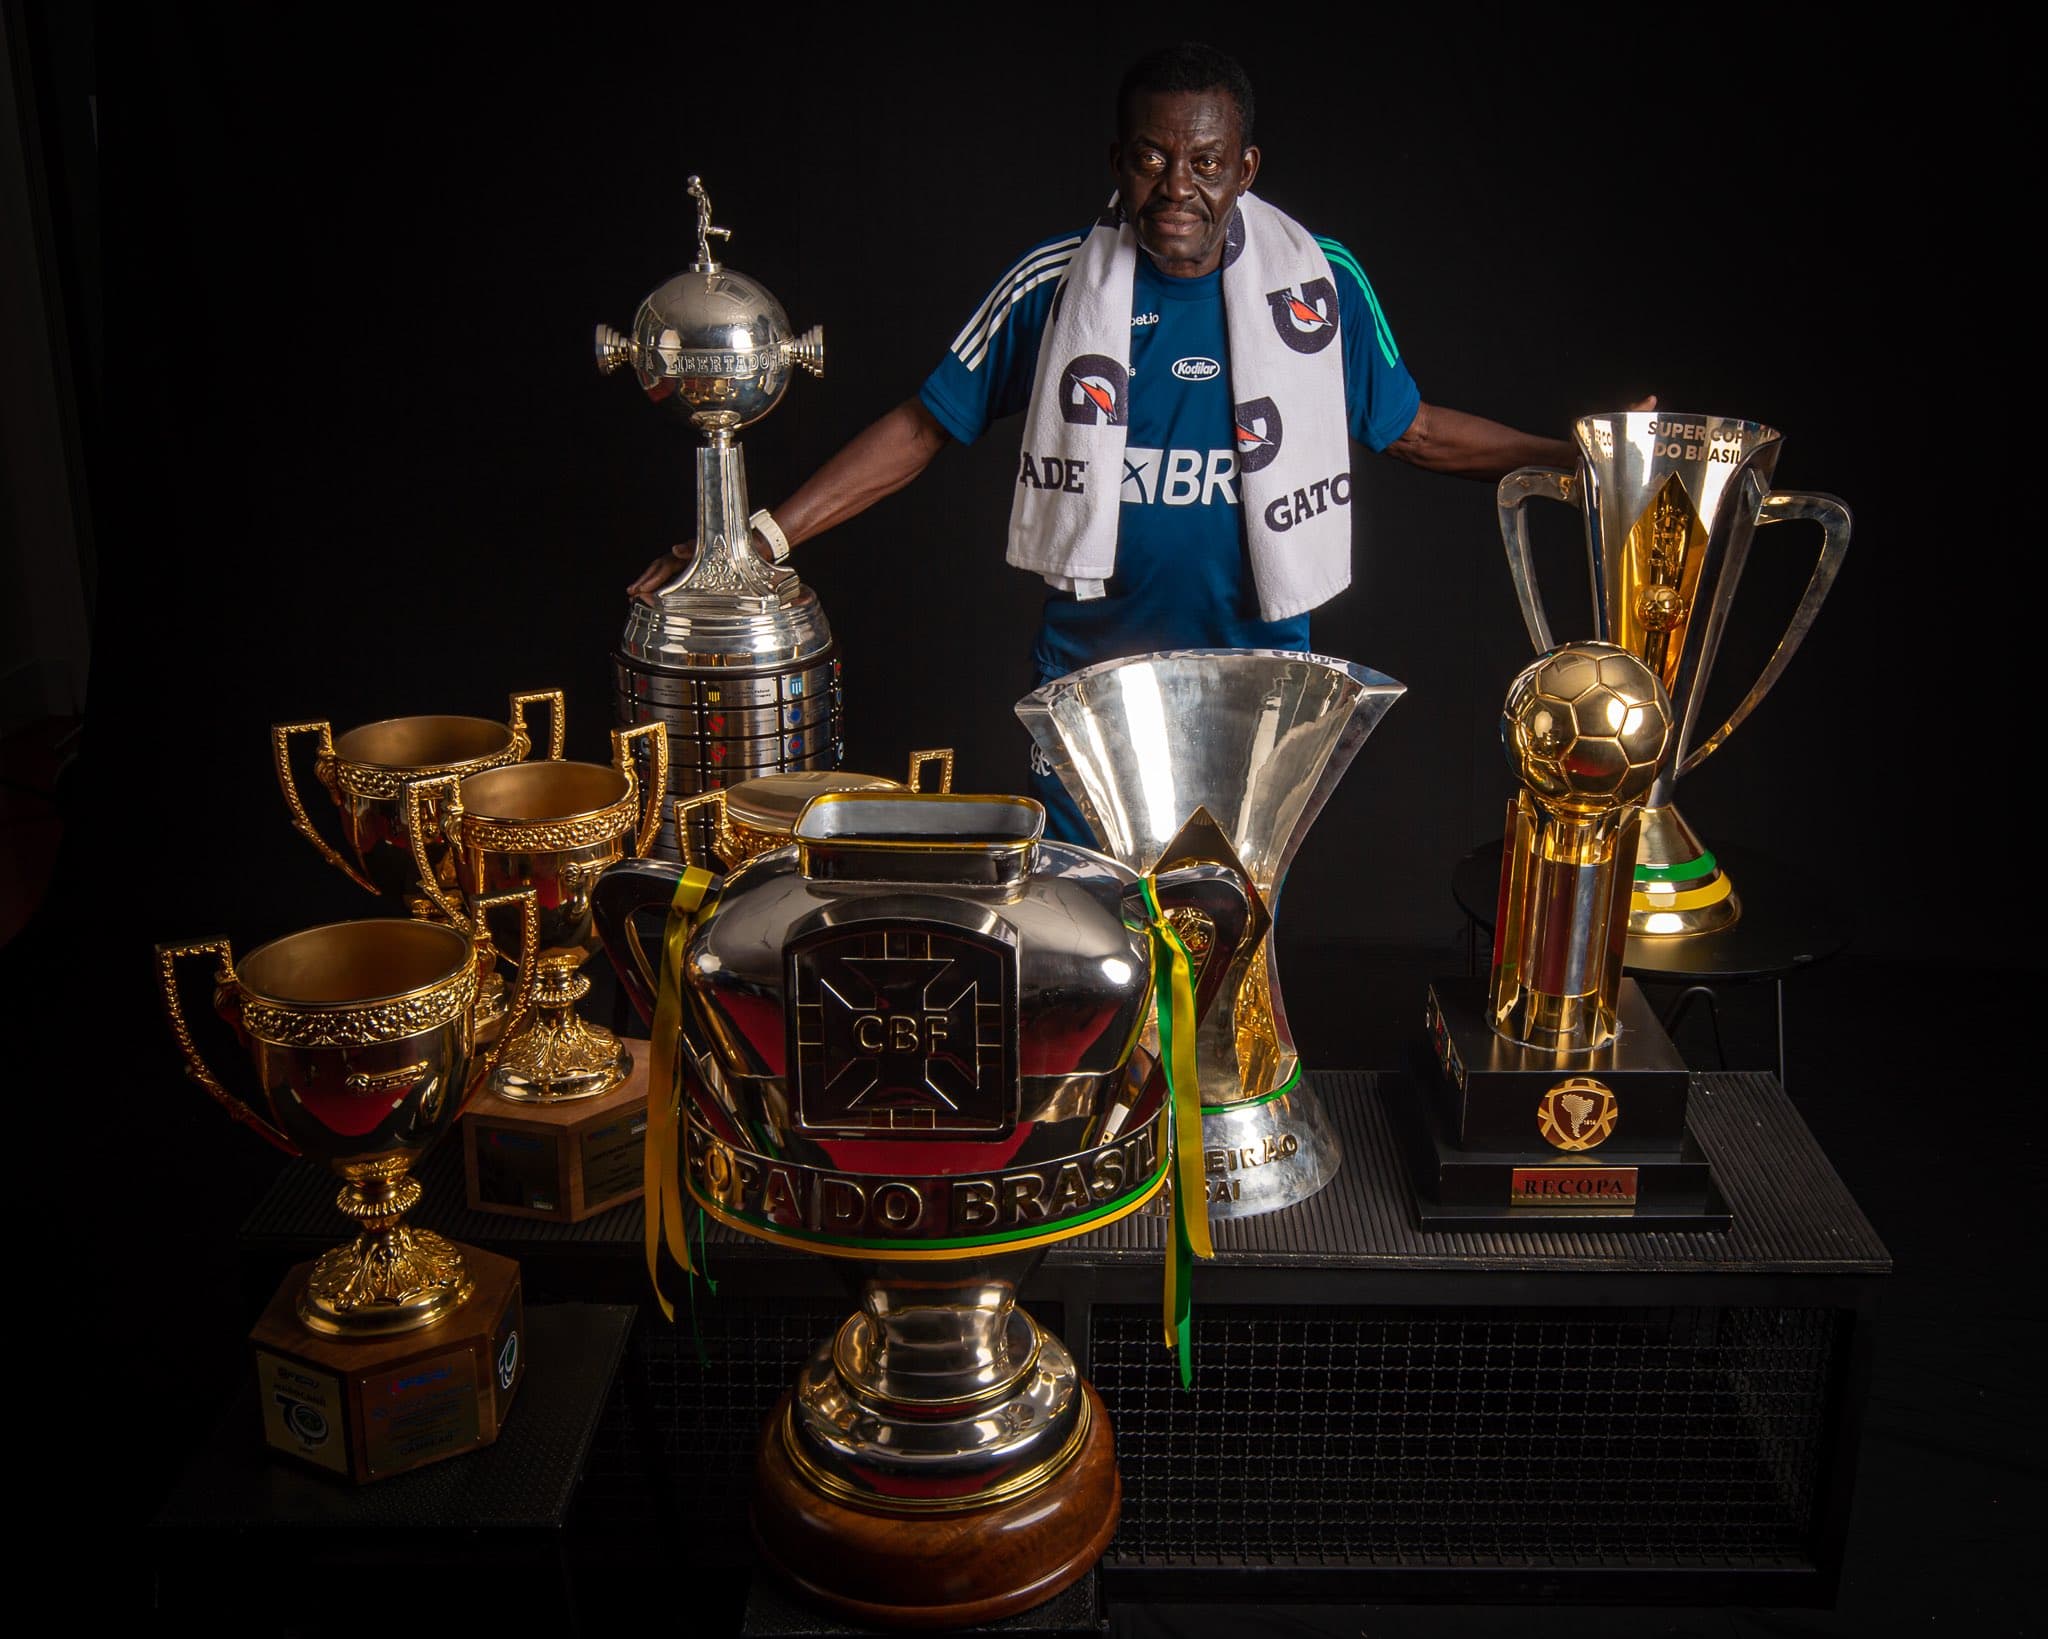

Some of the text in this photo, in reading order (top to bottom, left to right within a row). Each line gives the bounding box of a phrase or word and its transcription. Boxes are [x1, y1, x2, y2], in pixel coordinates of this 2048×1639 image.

[1177, 361, 1217, 376] Kodilar
[1648, 421, 1706, 441] SUPER
[1654, 442, 1682, 459] DO
[1264, 472, 1351, 533] GATO
[852, 1015, 949, 1055] CBF
[816, 1178, 924, 1231] DO
[951, 1131, 1157, 1230] BRASIL
[1524, 1179, 1624, 1195] RECOPA
